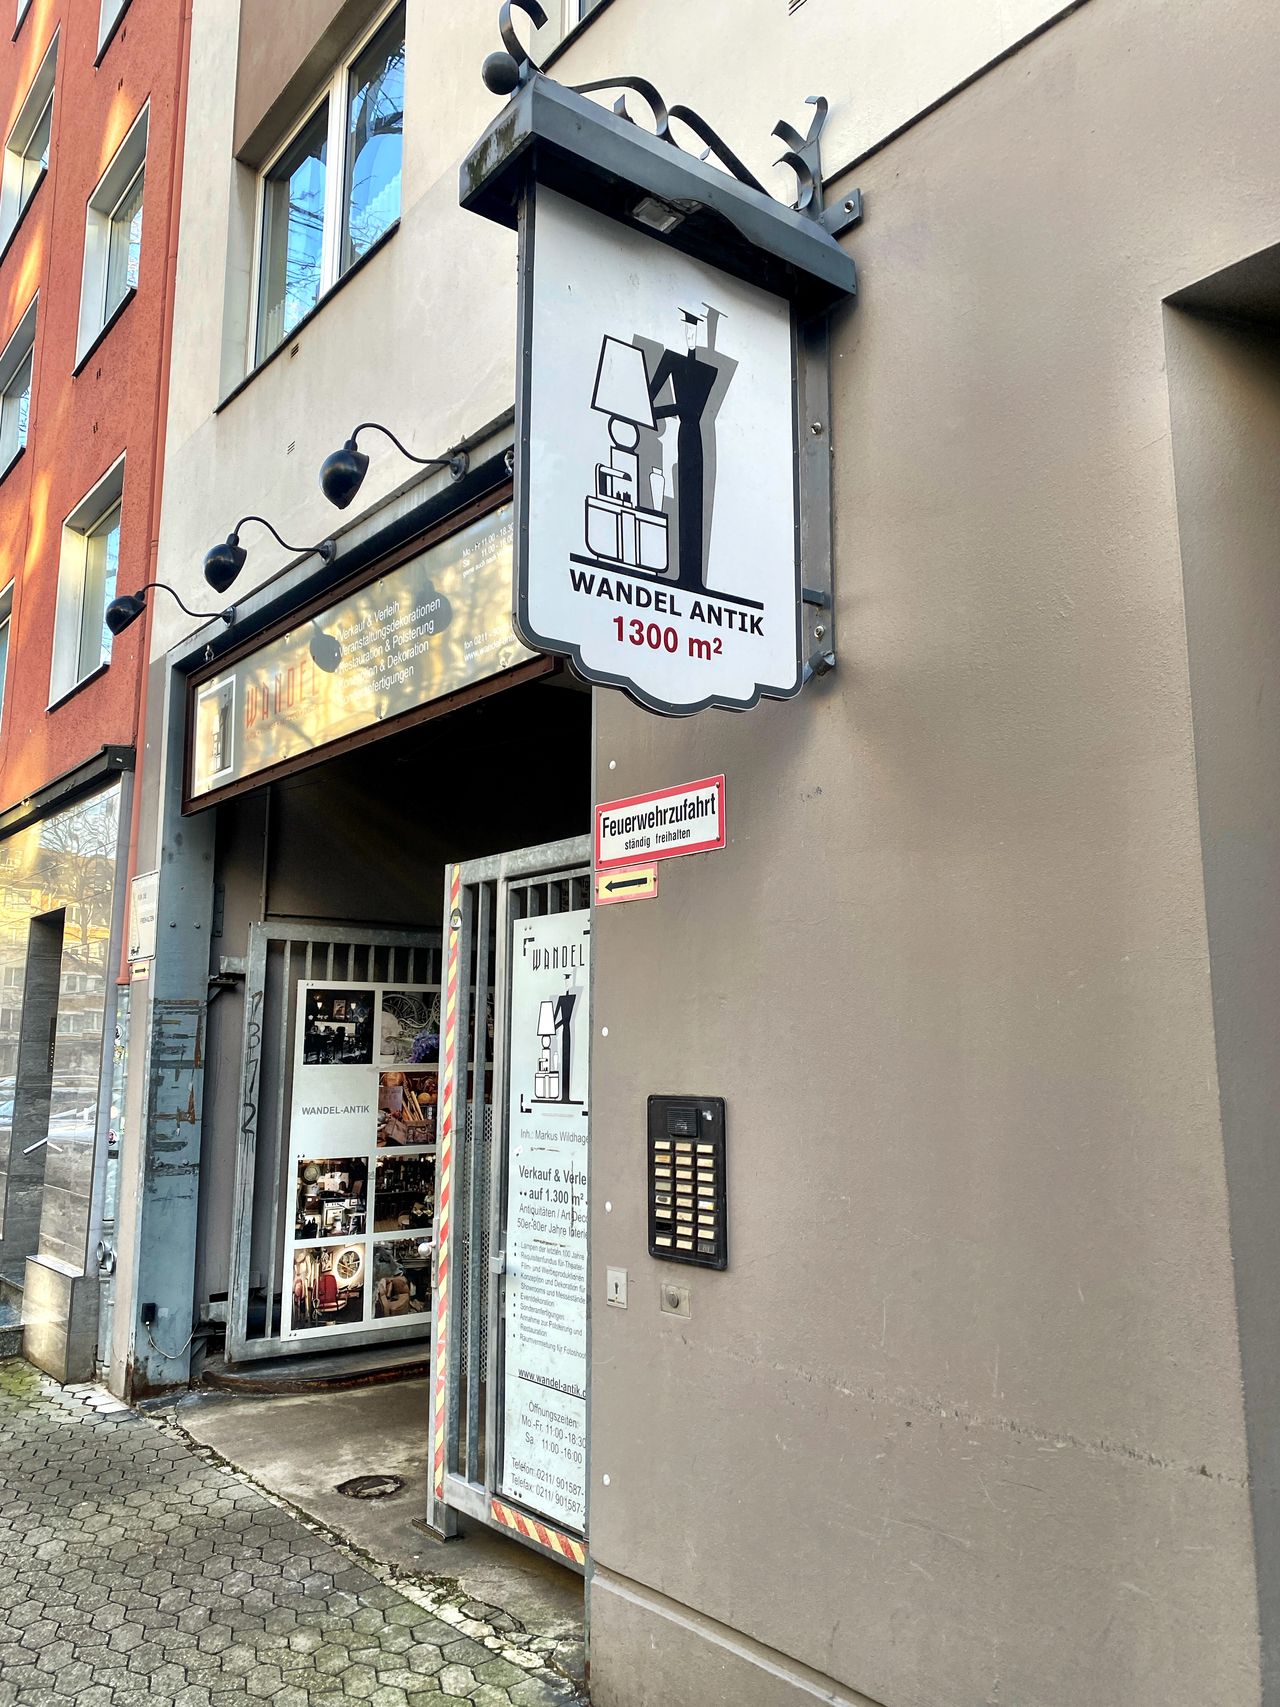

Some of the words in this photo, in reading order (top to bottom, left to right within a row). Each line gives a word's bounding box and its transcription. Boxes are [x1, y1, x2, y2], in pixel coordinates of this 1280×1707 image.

[569, 568, 682, 617] WANDEL
[689, 600, 765, 637] ANTIK
[339, 598, 441, 658] Veranstaltungsdekorationen
[340, 619, 366, 641] Verkauf
[367, 615, 372, 628] &
[374, 600, 400, 622] Verleih
[613, 615, 678, 654] 1300
[385, 638, 390, 652] &
[392, 620, 434, 648] Polsterung
[380, 658, 386, 672] &
[387, 640, 429, 668] Dekoration
[246, 655, 319, 729] WANDEL
[602, 792, 716, 838] Feuerwehrzufahrt
[624, 836, 651, 850] ständig
[655, 828, 691, 844] freihalten
[532, 944, 585, 972] WANDEL
[301, 1105, 370, 1116] WANDEL-ANTIK
[535, 1130, 558, 1142] Markus
[519, 1164, 552, 1182] Verkauf
[554, 1169, 560, 1182] &
[519, 1202, 556, 1218] Antiquitäten
[561, 1209, 571, 1220] Art
[529, 1188, 543, 1200] auf
[546, 1189, 568, 1204] 1.300
[517, 1218, 548, 1232] 50er-80er
[549, 1222, 567, 1236] Jahre
